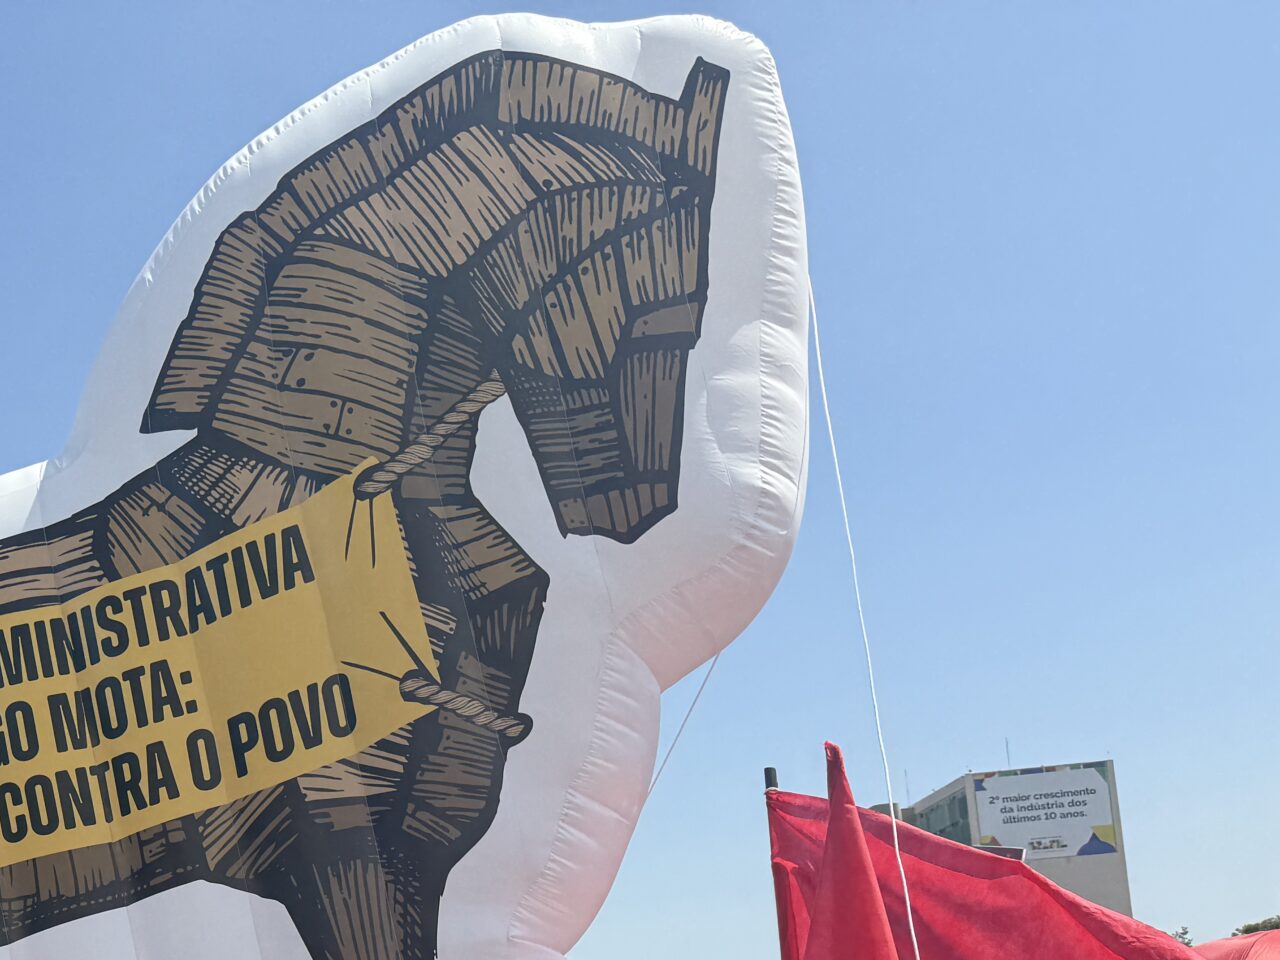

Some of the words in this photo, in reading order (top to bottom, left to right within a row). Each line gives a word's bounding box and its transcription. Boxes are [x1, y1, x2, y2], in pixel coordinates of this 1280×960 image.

[49, 659, 199, 752] MOTA:
[189, 728, 223, 791] O
[226, 673, 357, 778] POVO
[1002, 793, 1032, 804] maior
[1033, 787, 1097, 801] crescimento
[1000, 805, 1015, 814] da
[1016, 800, 1065, 813] indústria
[1067, 799, 1088, 808] dos
[1002, 812, 1042, 825] últimos
[1044, 811, 1057, 820] 10
[1060, 809, 1088, 819] anos.
